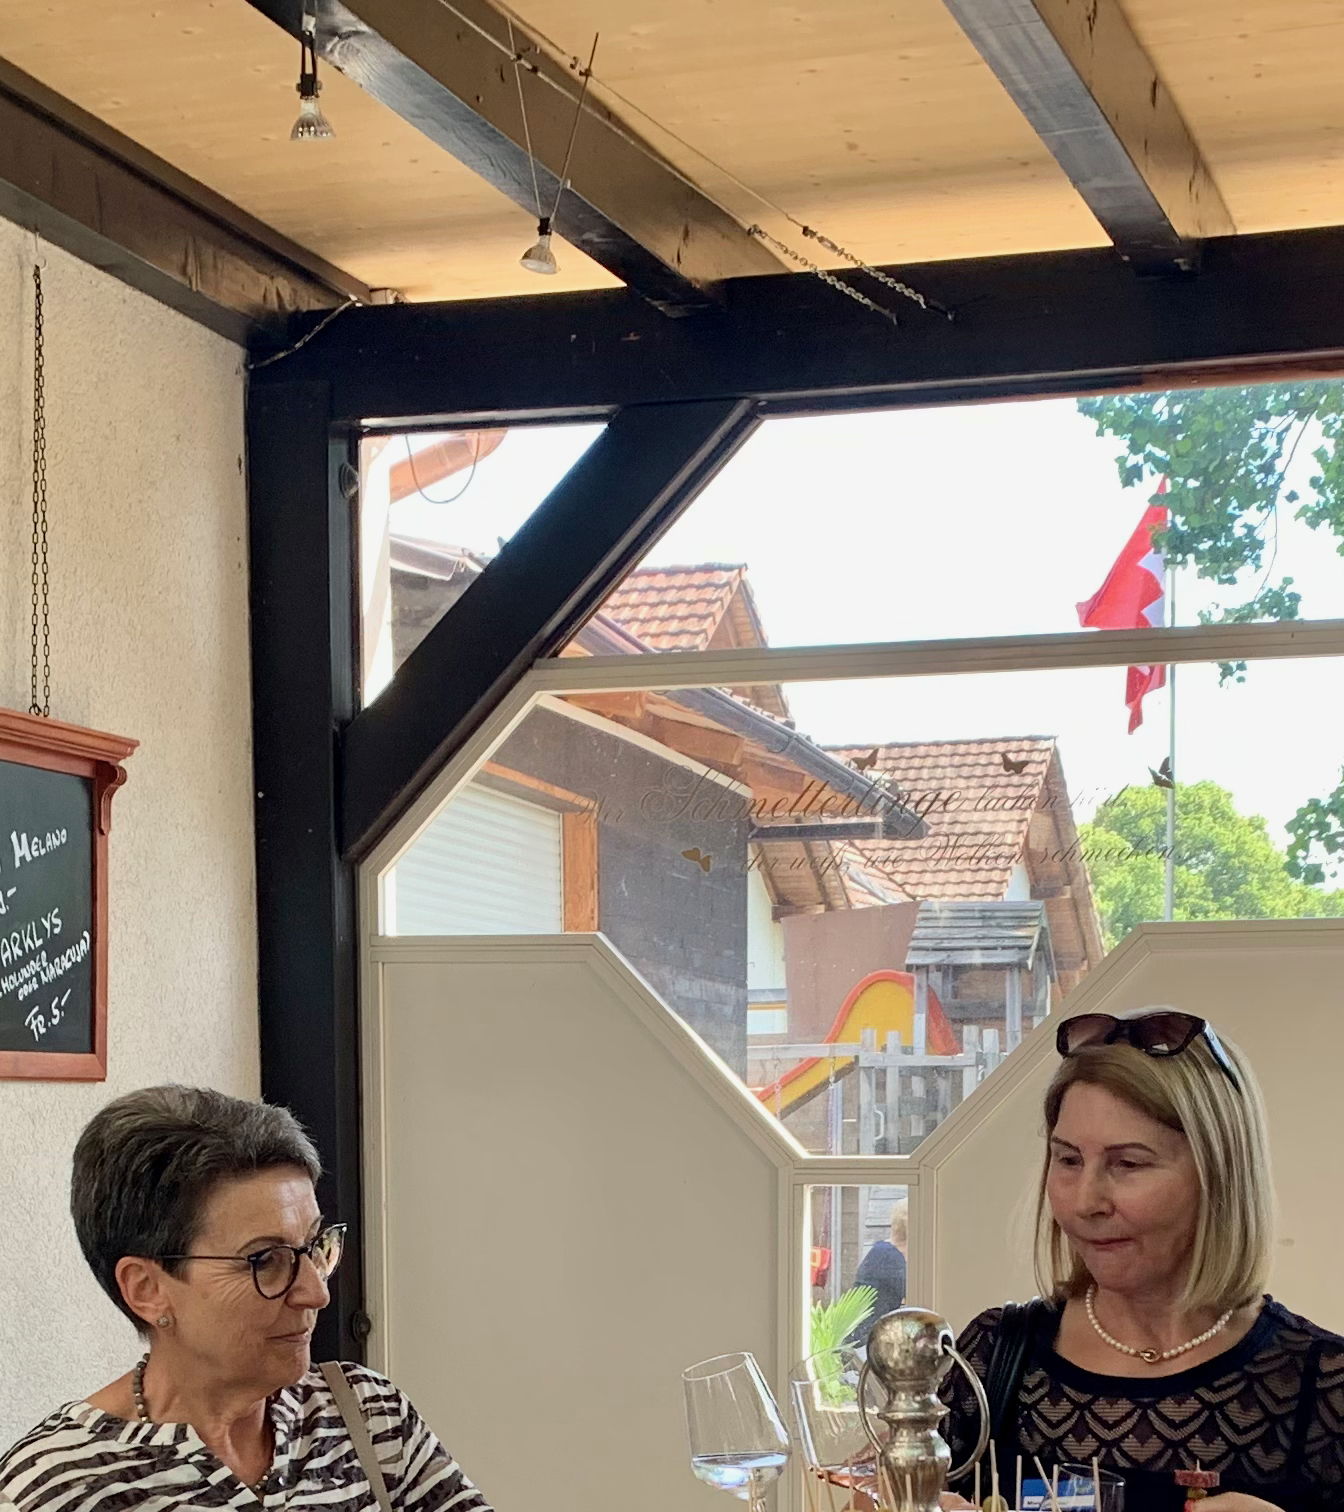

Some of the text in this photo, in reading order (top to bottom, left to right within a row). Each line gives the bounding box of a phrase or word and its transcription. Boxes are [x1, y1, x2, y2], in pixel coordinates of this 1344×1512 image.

[640, 765, 962, 837] Schmetterlinge
[973, 780, 1057, 812] lachen
[740, 848, 785, 873] der
[863, 852, 906, 871] wie
[920, 831, 1025, 870] Wolken
